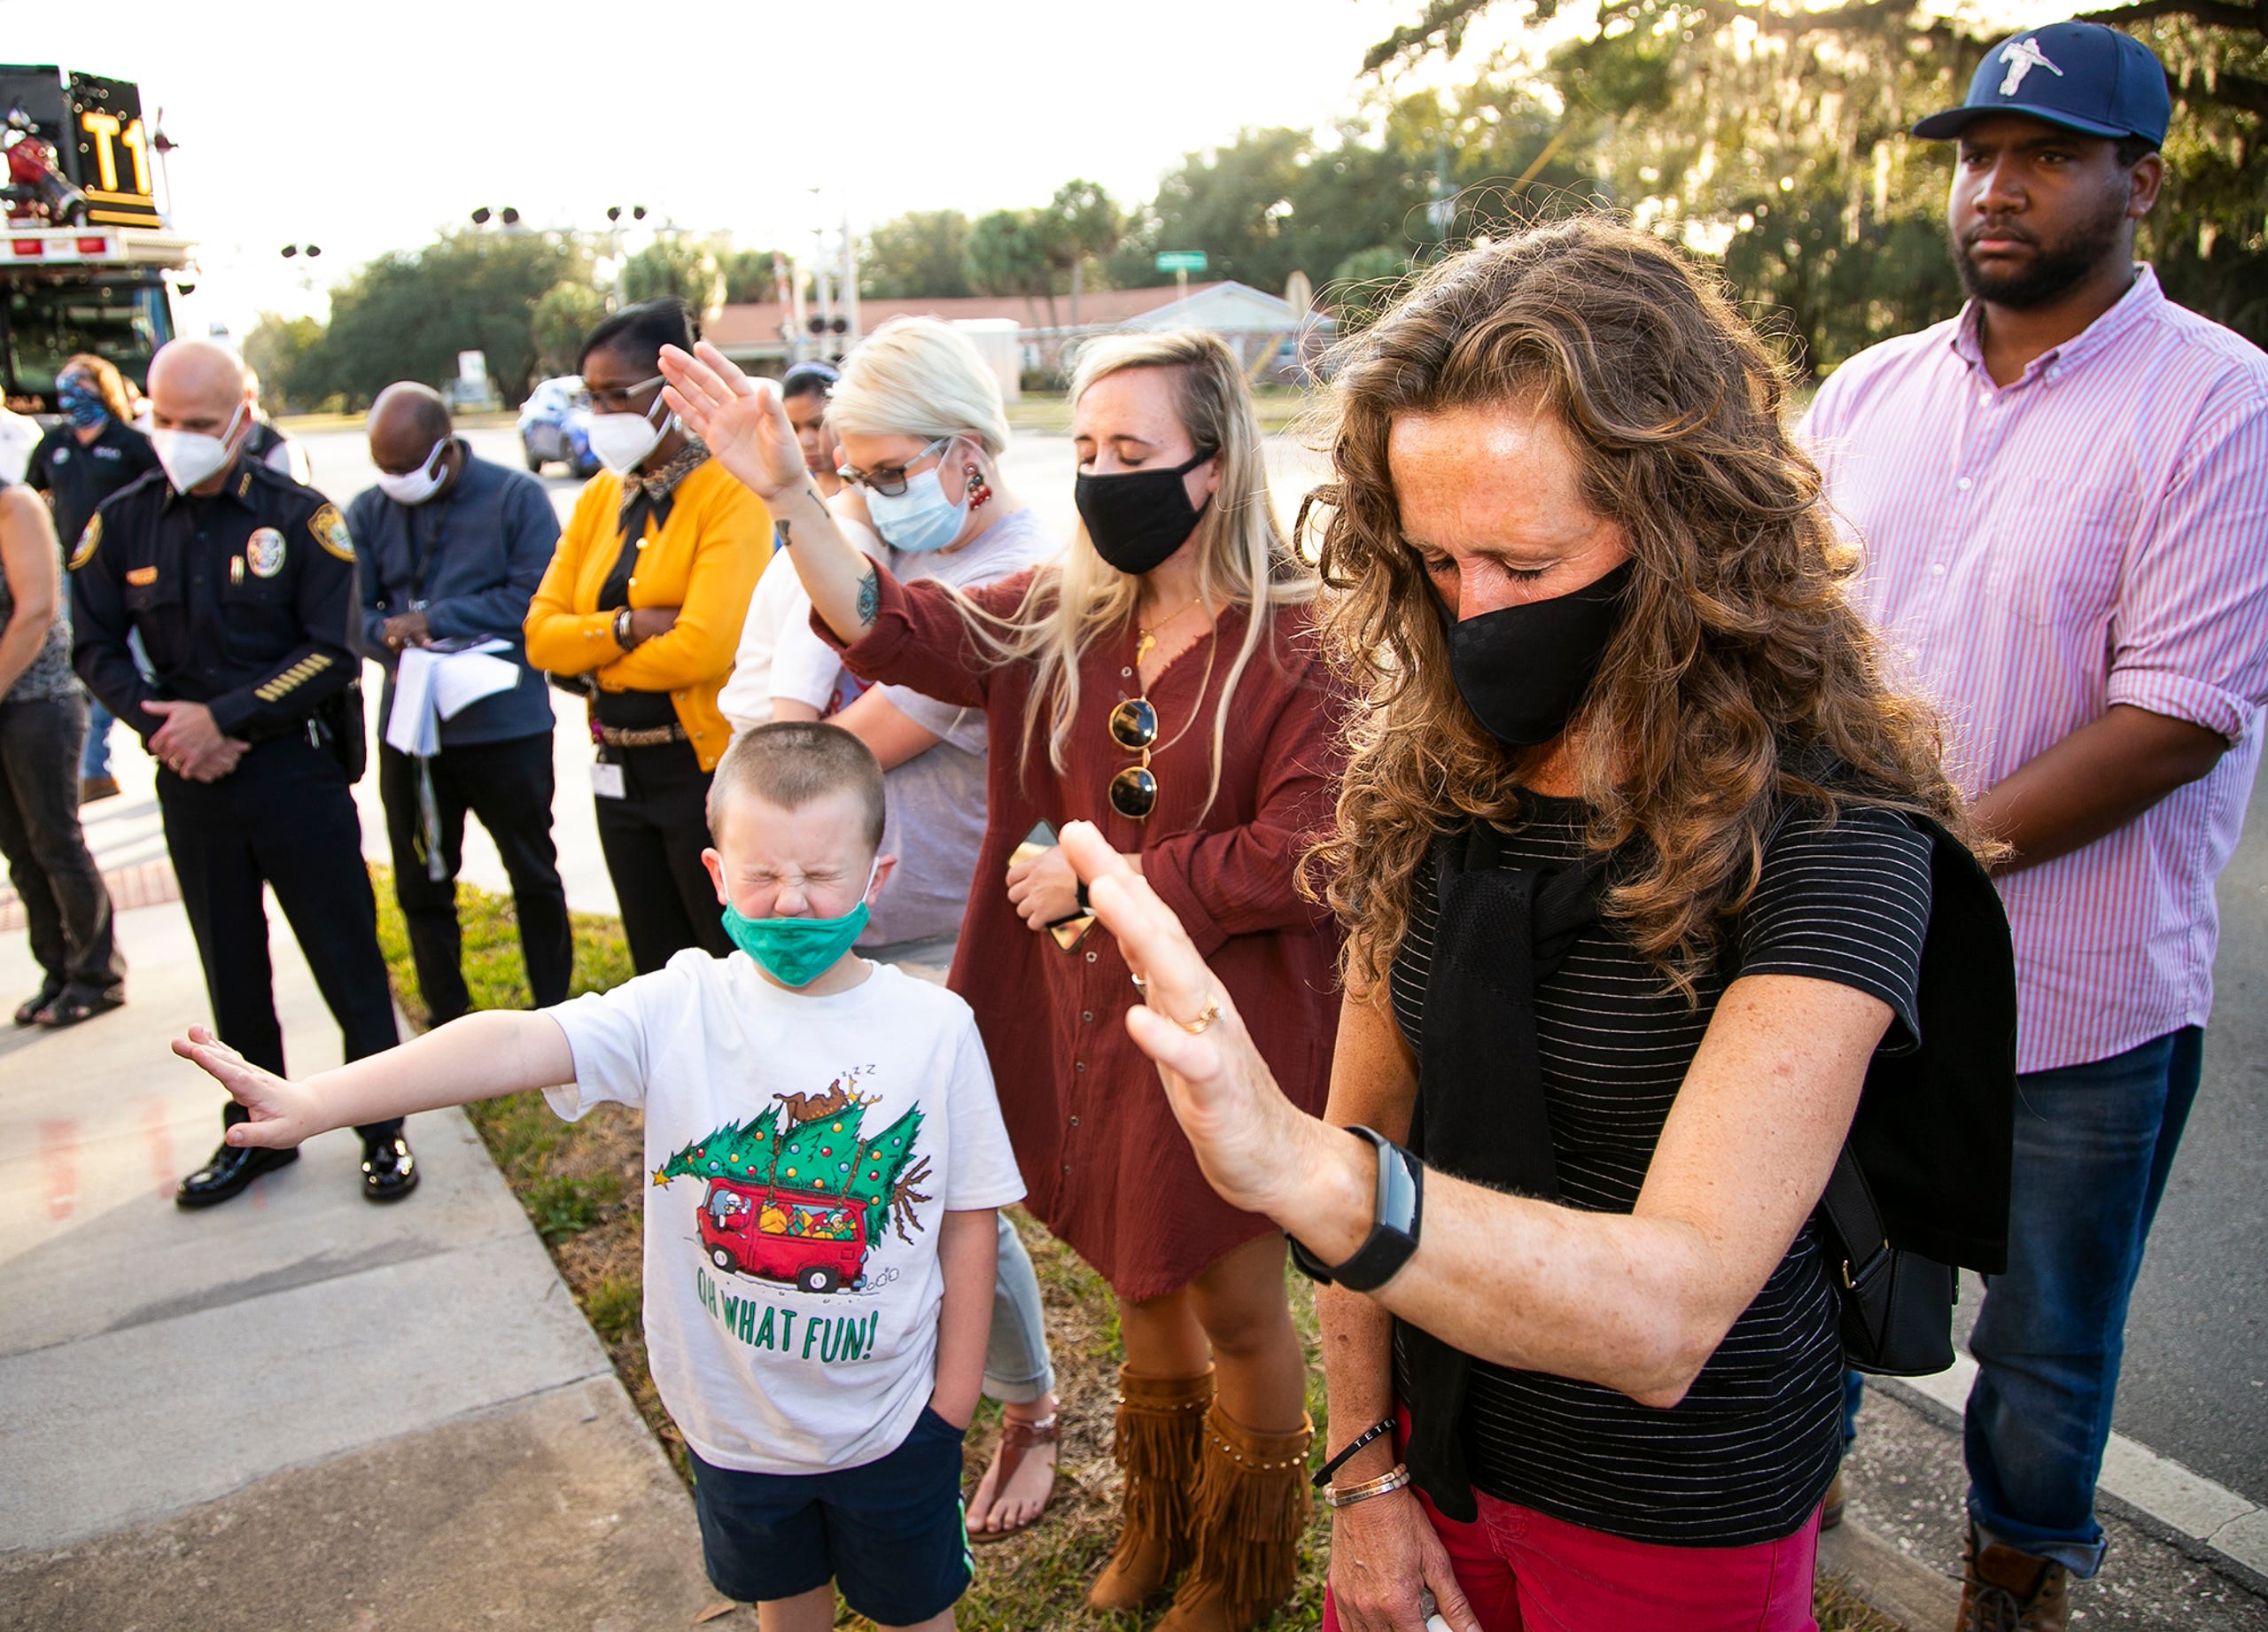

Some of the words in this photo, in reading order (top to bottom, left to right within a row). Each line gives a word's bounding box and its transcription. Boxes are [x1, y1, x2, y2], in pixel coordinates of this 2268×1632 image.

[82, 112, 152, 195] T1
[697, 1267, 718, 1319] OH
[720, 1289, 797, 1352] WHAT
[802, 1310, 879, 1364] FUN!
